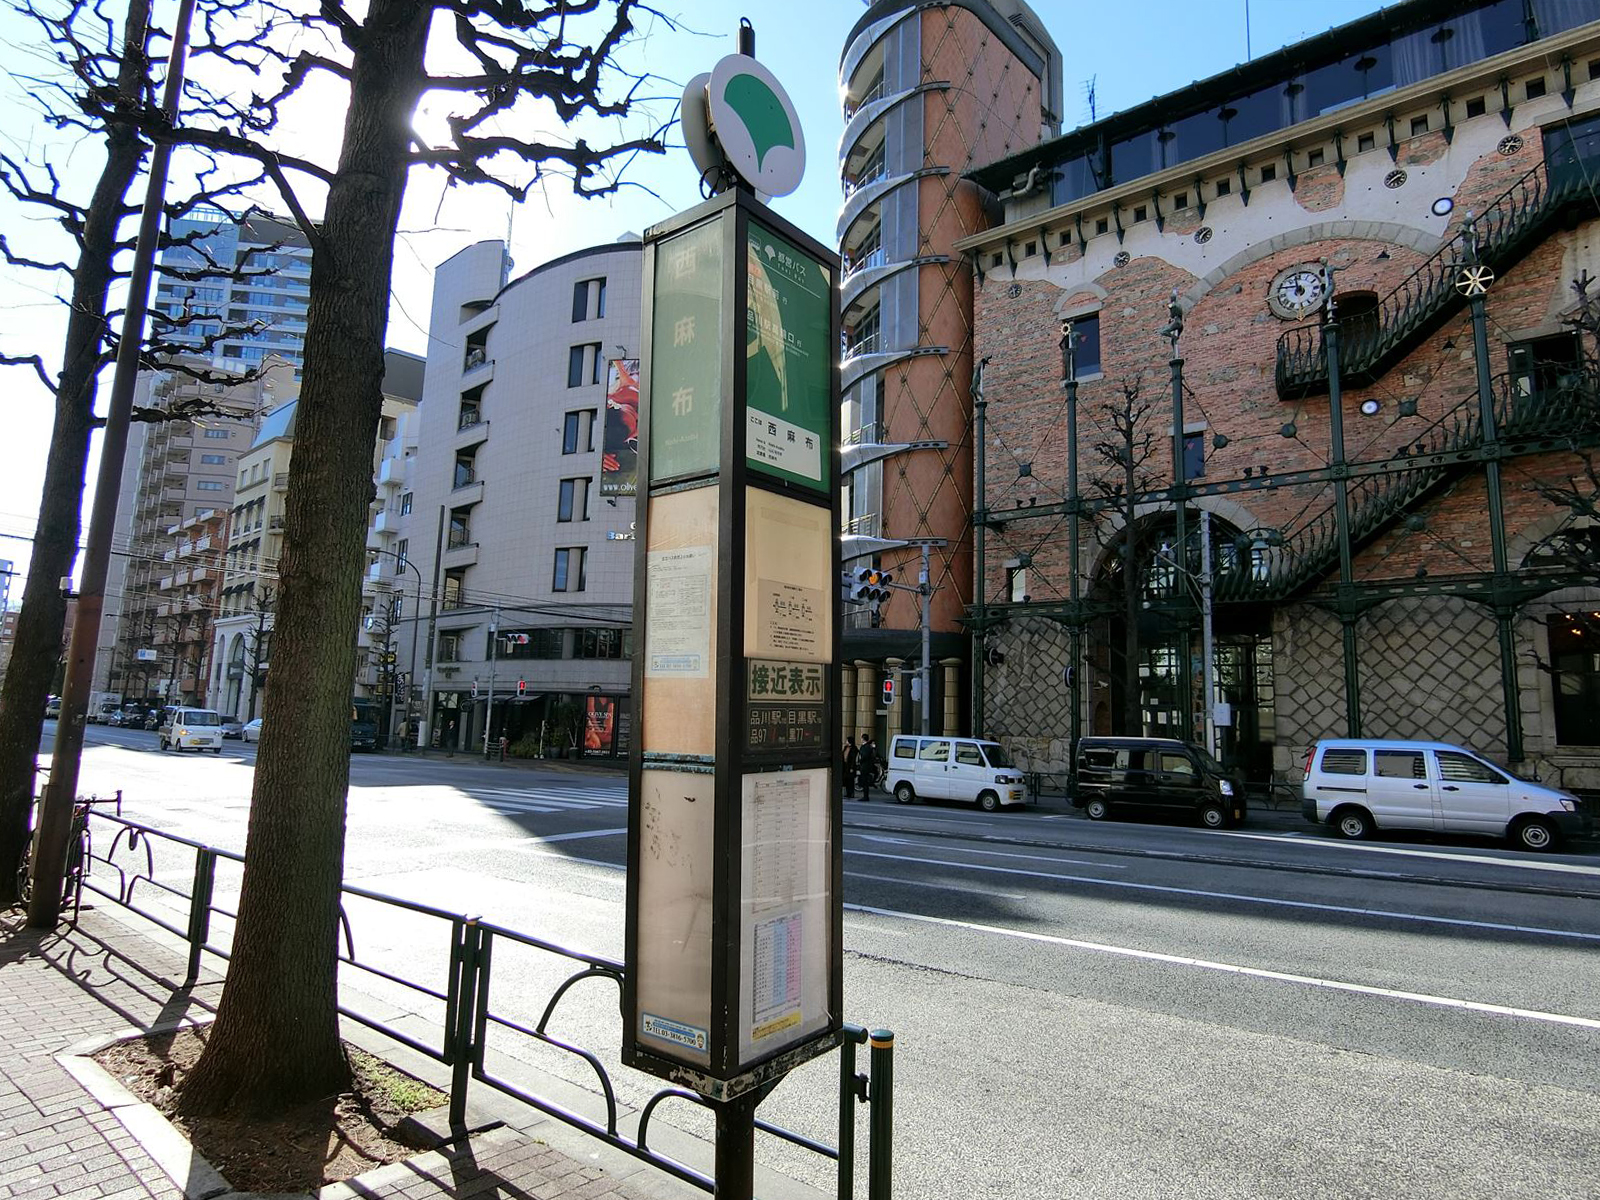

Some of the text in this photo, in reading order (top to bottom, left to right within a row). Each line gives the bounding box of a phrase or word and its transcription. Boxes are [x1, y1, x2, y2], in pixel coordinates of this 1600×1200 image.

[777, 251, 806, 276] 都営バス
[672, 246, 697, 416] 西麻布
[750, 416, 763, 426] ここは
[767, 421, 814, 450] 西麻布
[752, 664, 821, 696] 接近表示
[750, 710, 781, 725] 品川駅
[788, 710, 817, 725] 目黒駅
[750, 728, 767, 744] 品97
